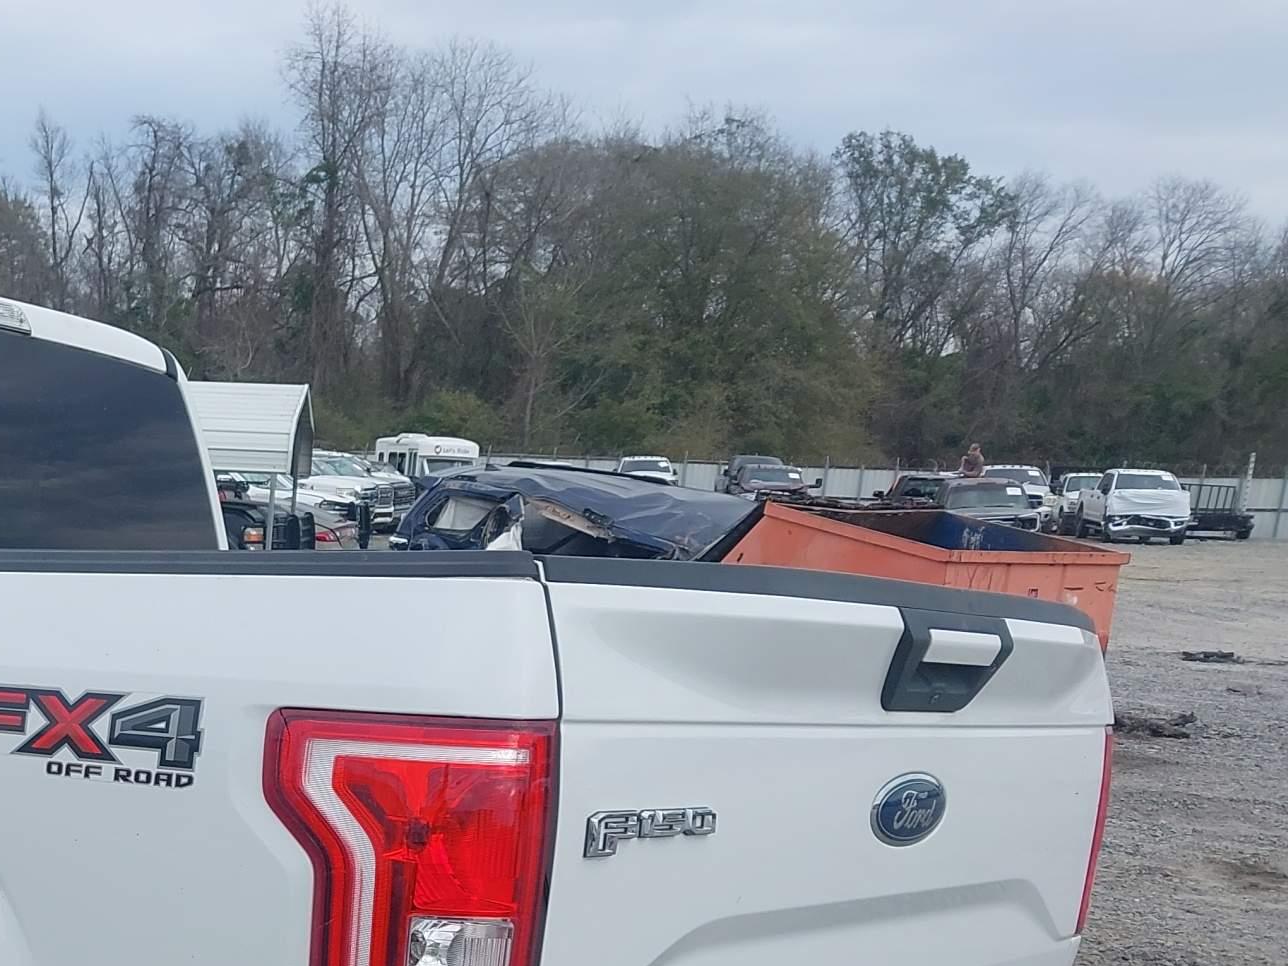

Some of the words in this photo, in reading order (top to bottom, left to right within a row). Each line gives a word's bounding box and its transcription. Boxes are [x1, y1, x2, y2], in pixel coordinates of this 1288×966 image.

[46, 760, 103, 780] OFF
[113, 766, 194, 788] ROAD
[893, 789, 936, 831] Ford
